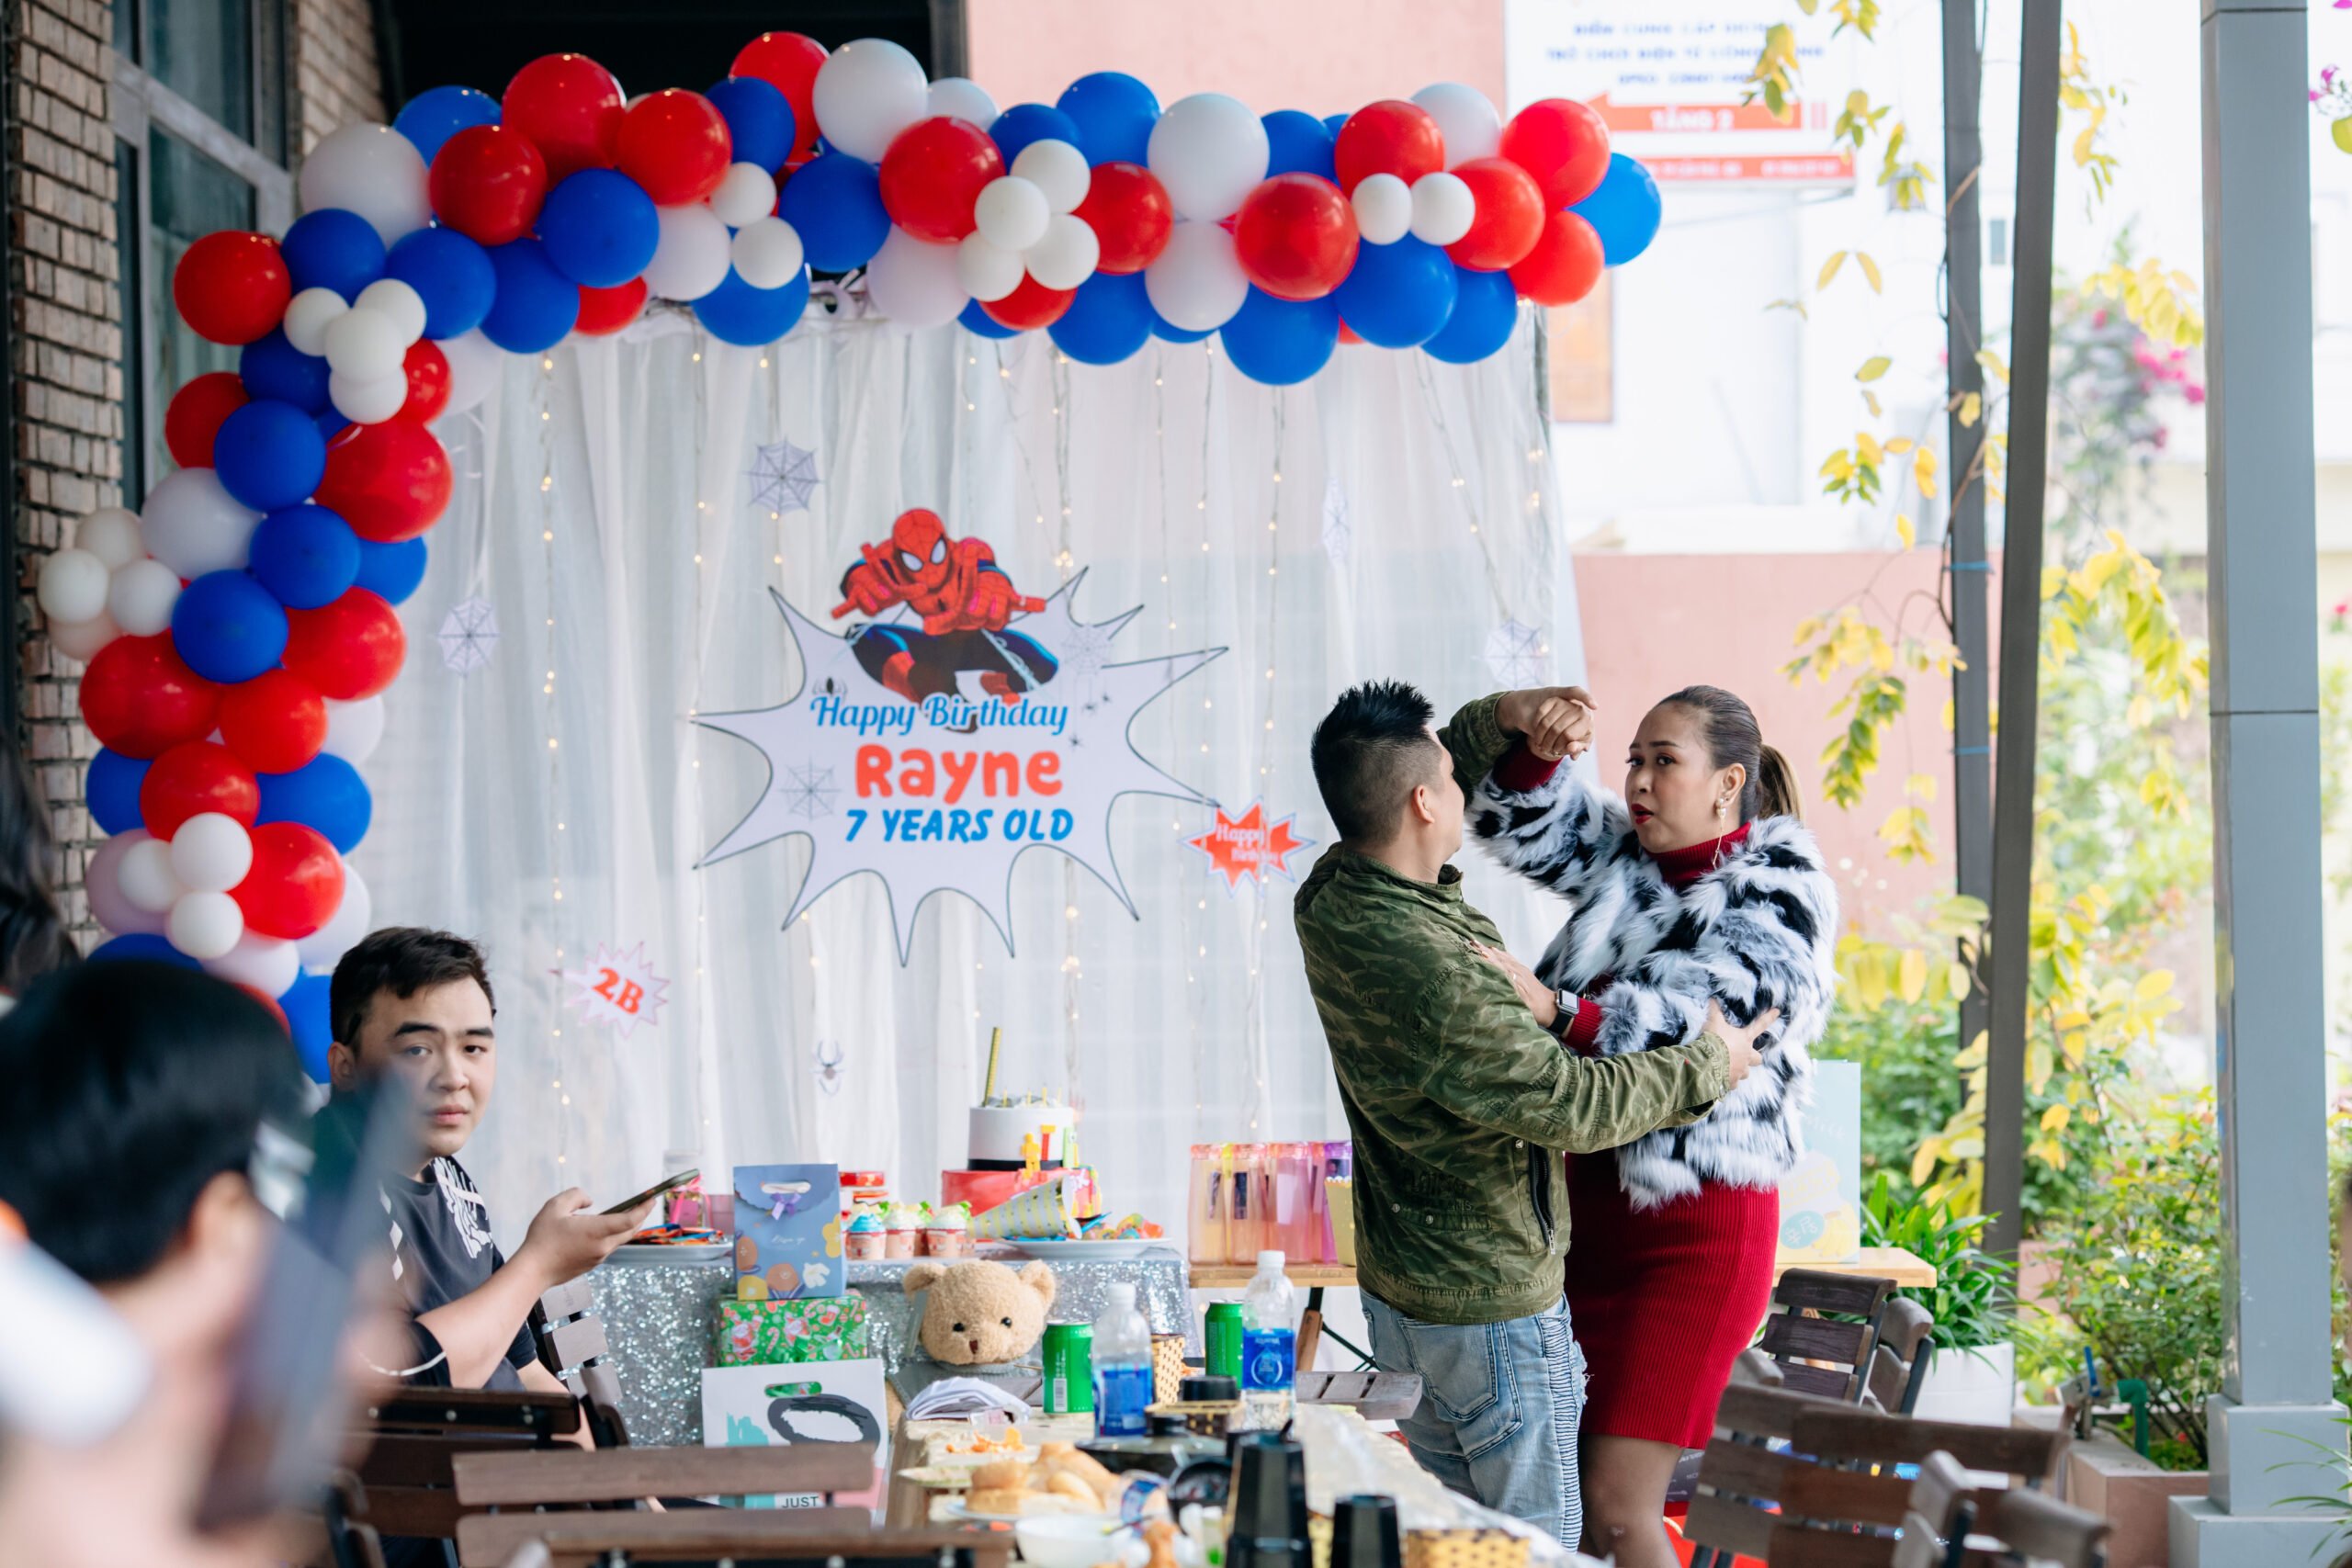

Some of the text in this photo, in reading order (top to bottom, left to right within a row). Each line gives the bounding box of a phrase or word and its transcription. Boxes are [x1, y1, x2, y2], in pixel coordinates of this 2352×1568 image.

[809, 695, 1069, 736] Happy Birthday
[854, 743, 1064, 806] Rayne
[845, 808, 1074, 843] 7 YEARS OLD
[591, 967, 644, 1014] 2B
[782, 1495, 820, 1508] JUST
